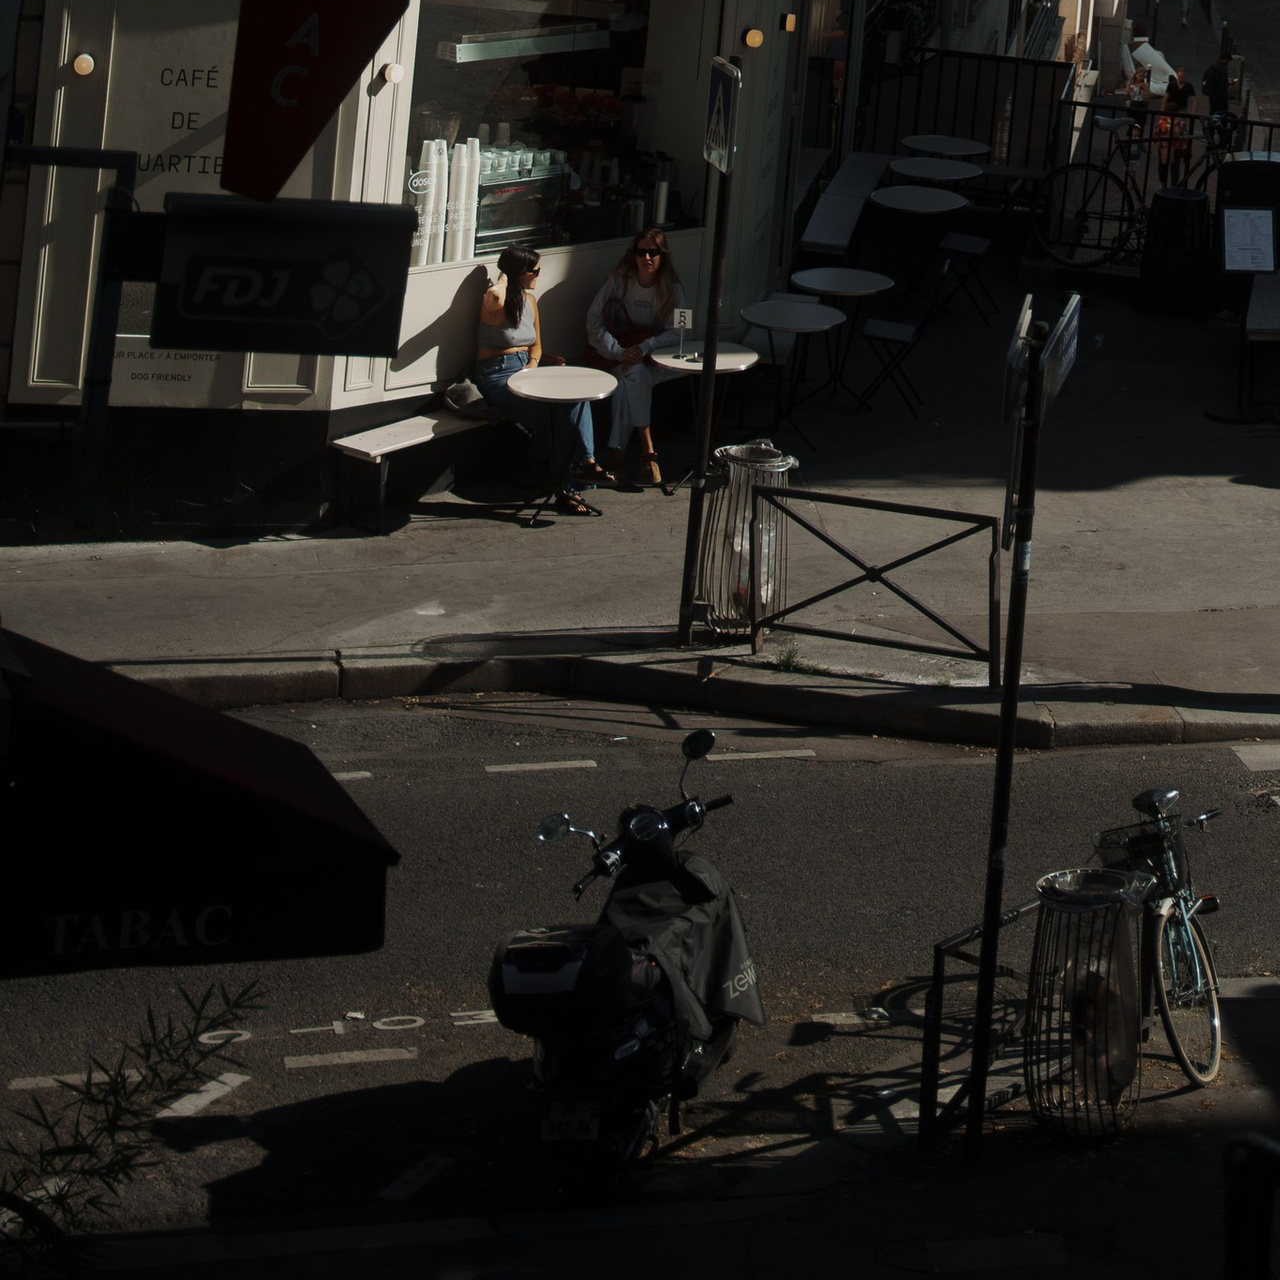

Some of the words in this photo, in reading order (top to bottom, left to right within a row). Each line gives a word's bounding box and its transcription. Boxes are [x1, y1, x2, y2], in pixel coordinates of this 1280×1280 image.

[161, 66, 219, 88] CAFÉ
[172, 112, 200, 130] DE
[138, 154, 225, 175] UARTIE
[191, 266, 292, 308] FDJ
[127, 351, 155, 359] PLACE
[174, 352, 221, 361] EMPORTER
[131, 372, 149, 380] DOG
[151, 373, 192, 382] FRIENDLY
[43, 903, 233, 956] TABAC
